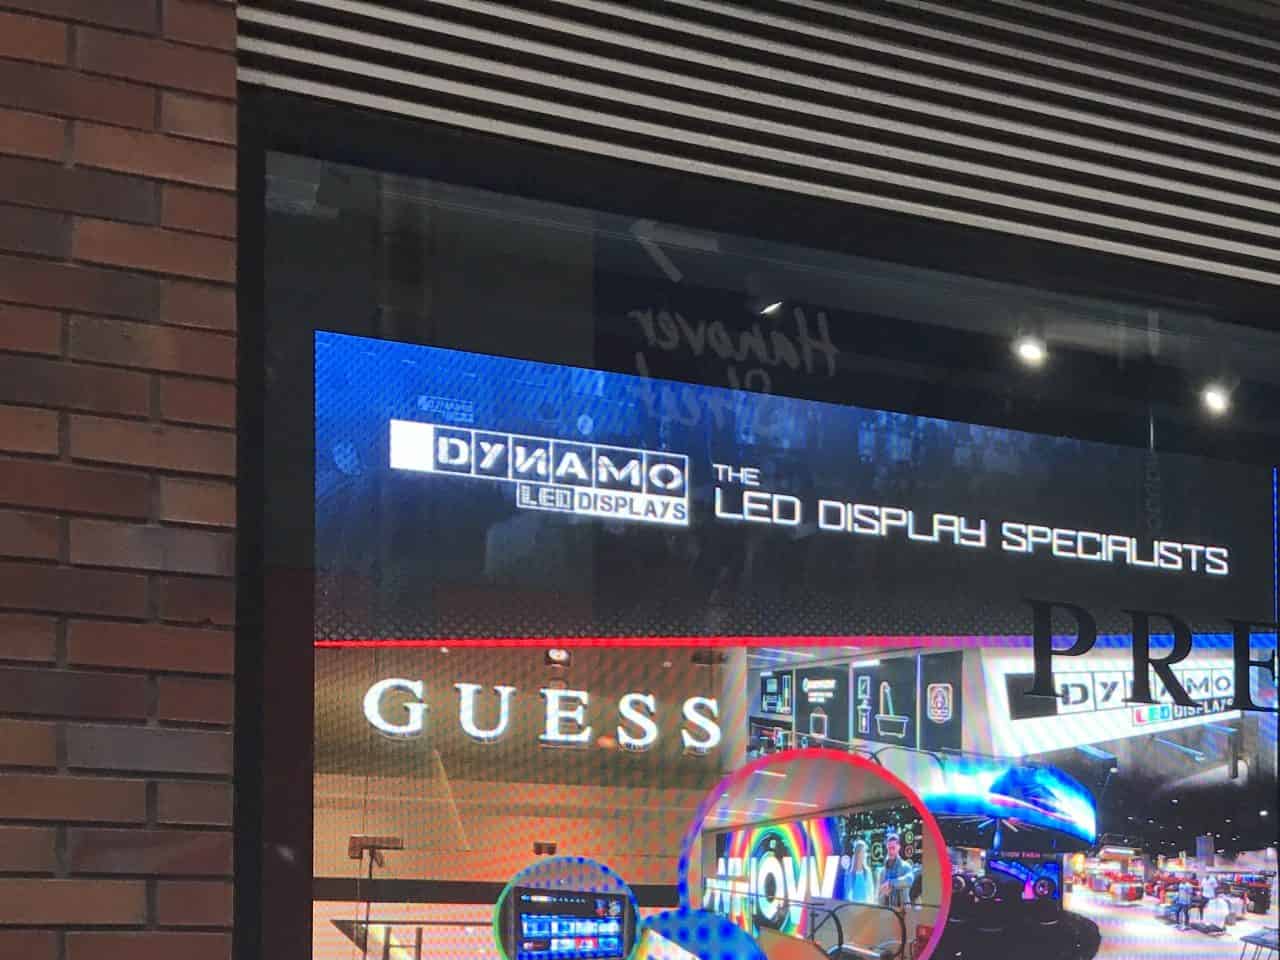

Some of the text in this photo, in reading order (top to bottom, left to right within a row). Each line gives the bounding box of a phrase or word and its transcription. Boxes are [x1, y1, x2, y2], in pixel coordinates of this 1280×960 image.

[436, 428, 687, 493] DYNAMO
[712, 463, 760, 487] THE
[519, 484, 687, 522] LED DISPLAYS
[714, 487, 1230, 577] LED DISPLAY SPECIALISTS
[362, 677, 723, 752] GUESS
[1135, 704, 1171, 725] LED
